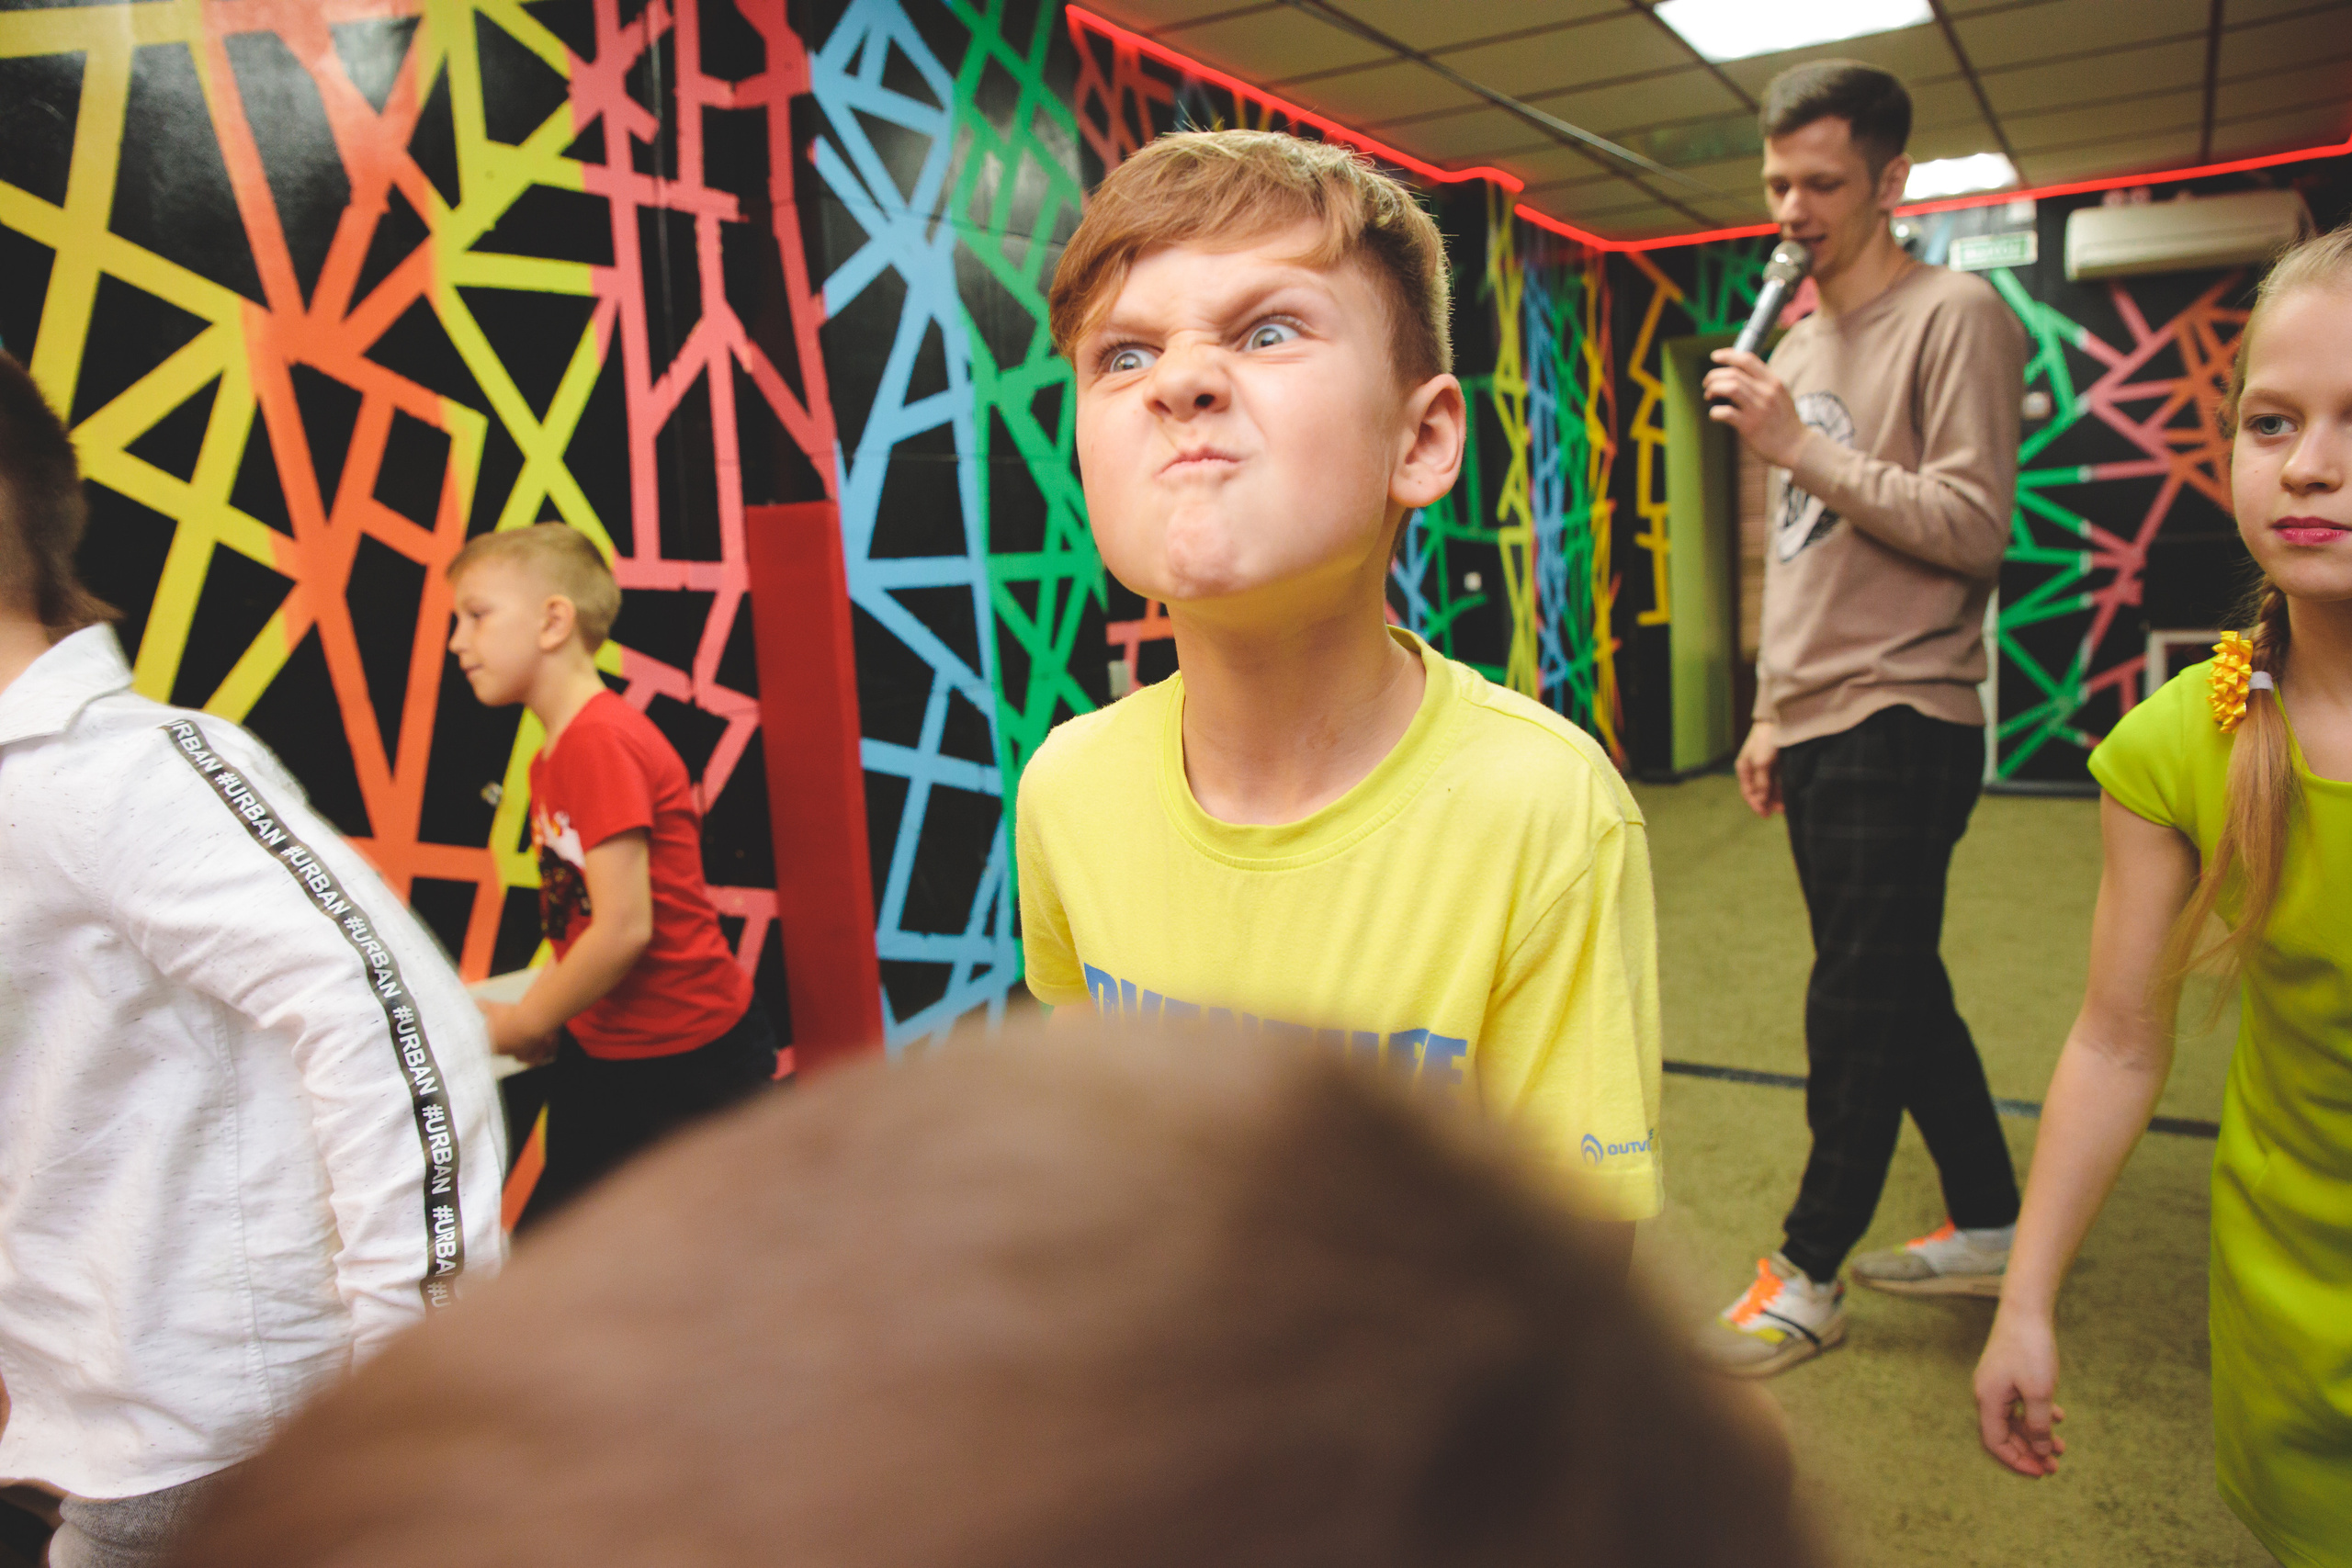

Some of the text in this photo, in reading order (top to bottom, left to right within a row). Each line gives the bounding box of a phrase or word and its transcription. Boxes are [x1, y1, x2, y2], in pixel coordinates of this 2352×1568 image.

[214, 772, 288, 846] #URBAN
[280, 845, 351, 916] #URBAN
[344, 915, 401, 998] #URBAN
[392, 1005, 439, 1096] #URBAN
[422, 1103, 453, 1195] #URBAN
[432, 1204, 457, 1278] #URBA
